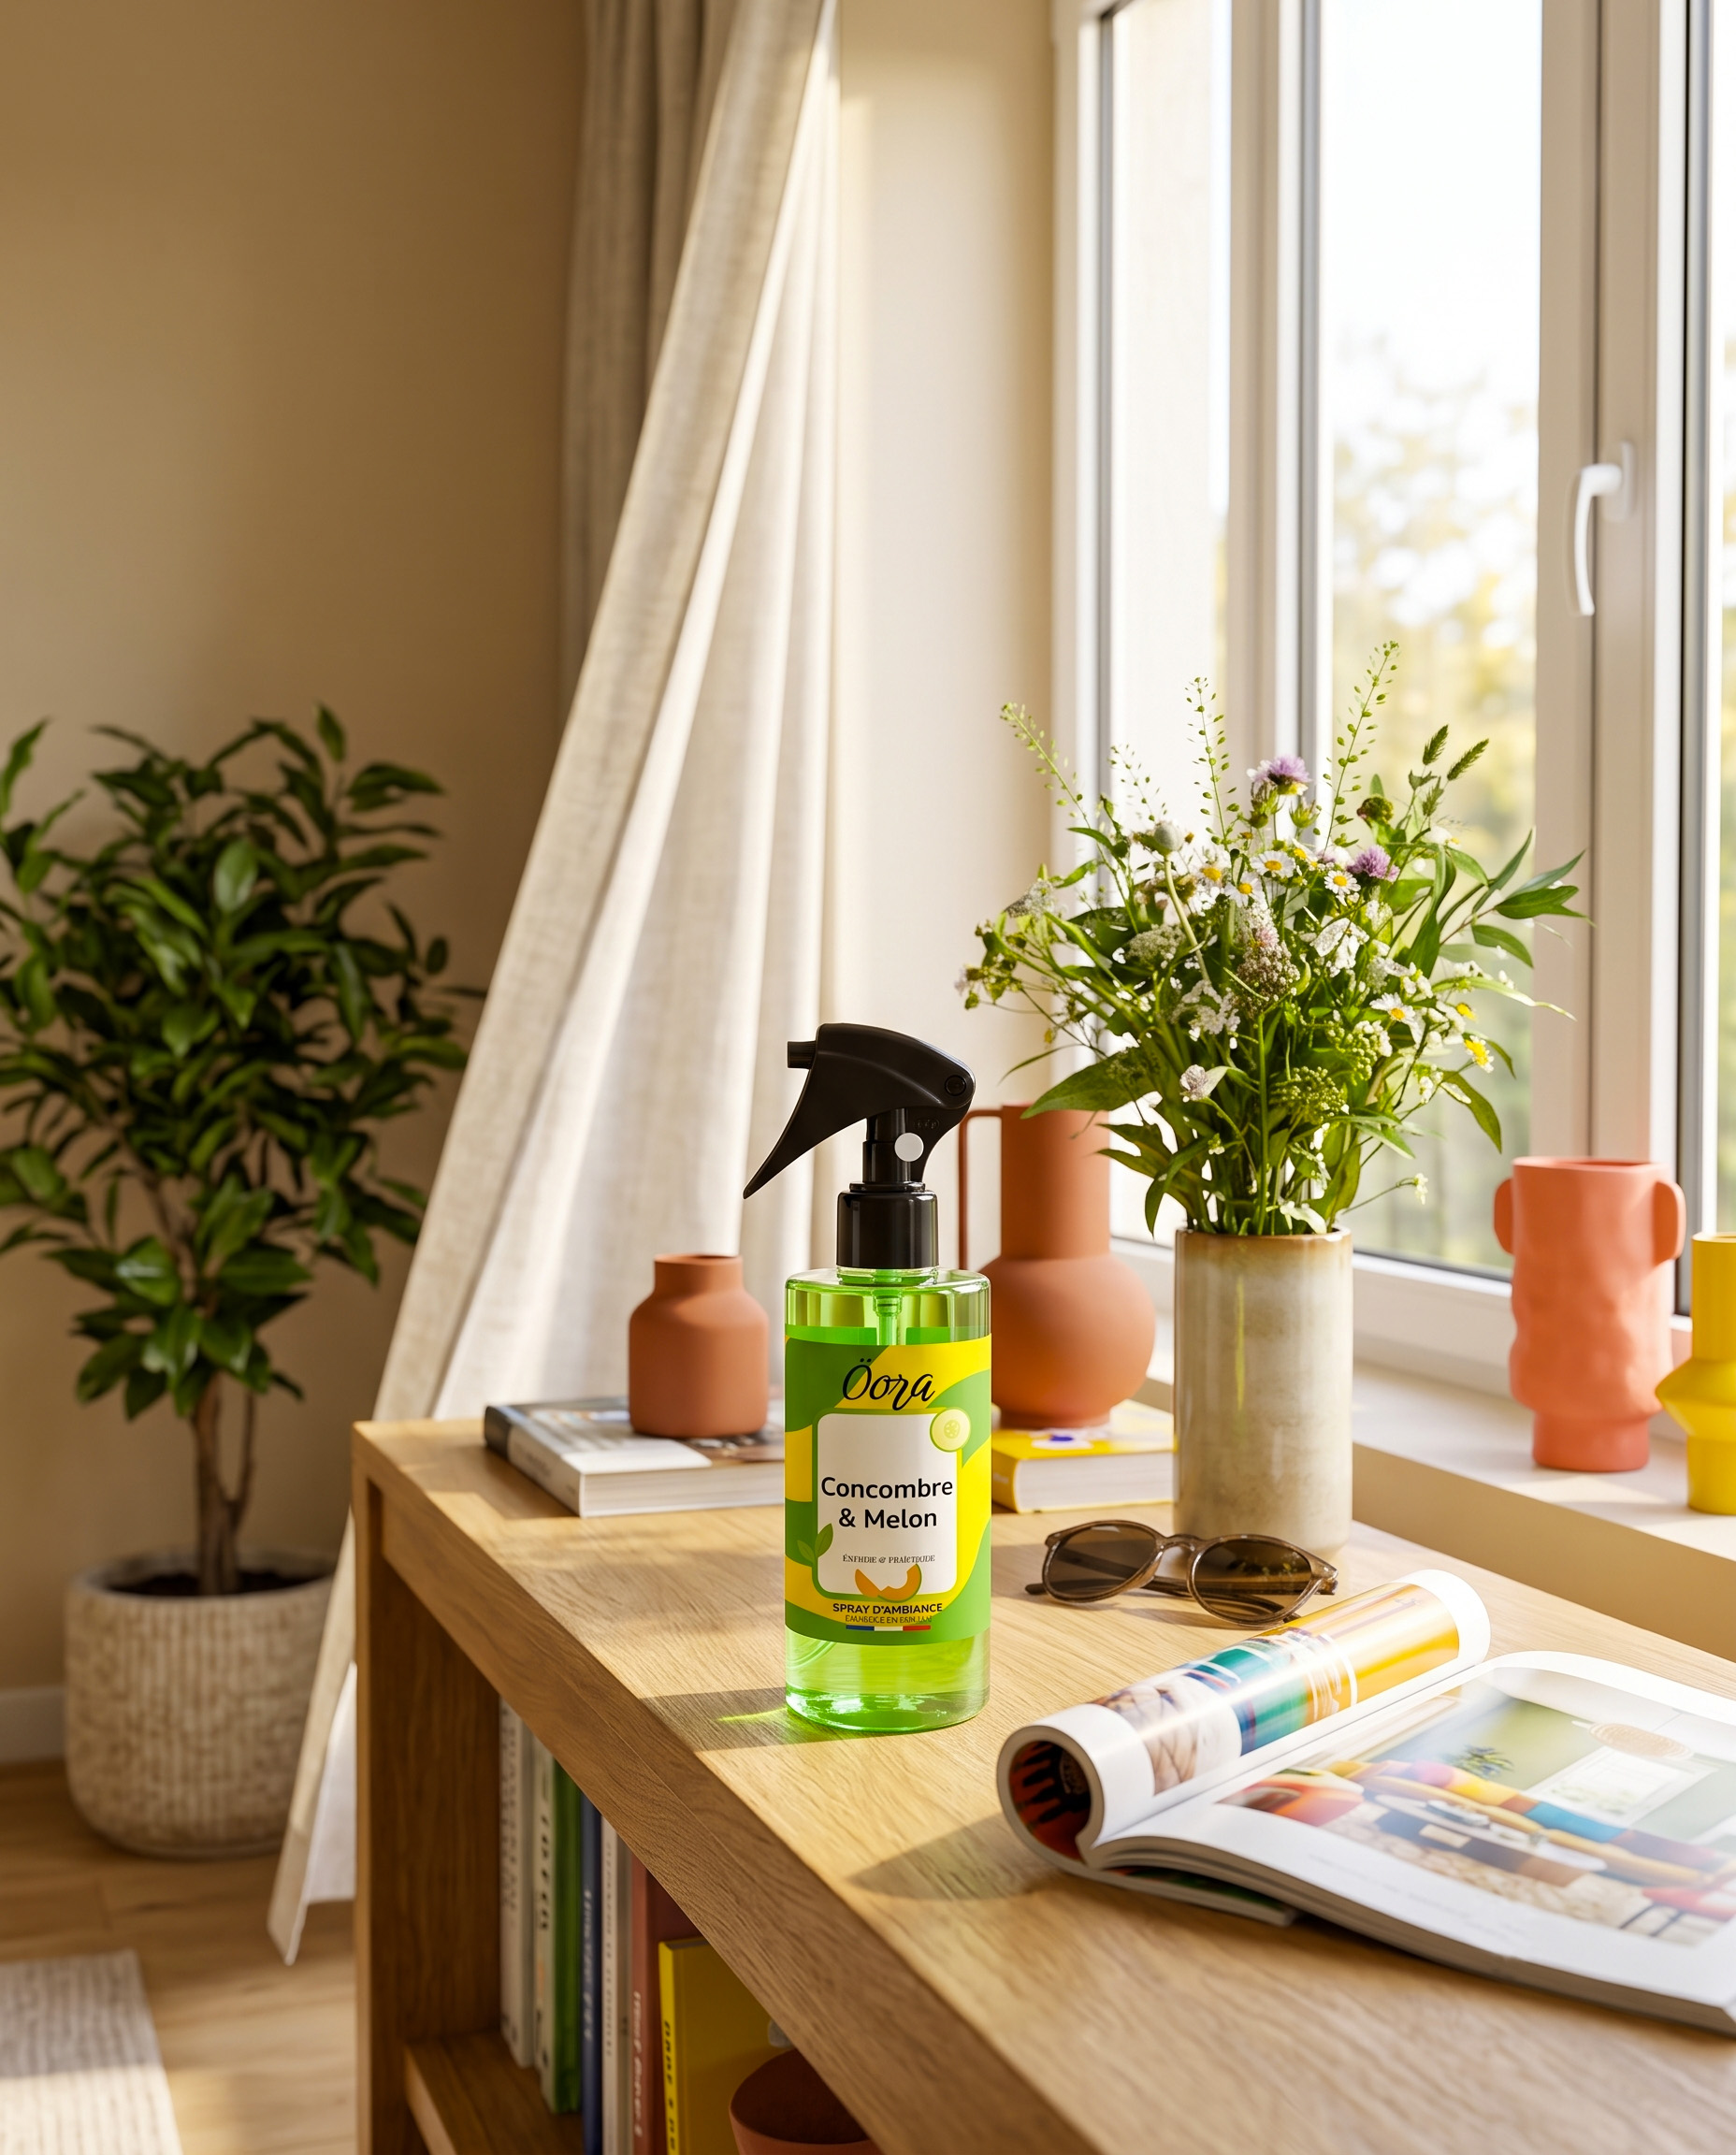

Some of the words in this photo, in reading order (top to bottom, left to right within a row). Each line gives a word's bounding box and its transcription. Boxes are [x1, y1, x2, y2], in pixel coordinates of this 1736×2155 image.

[842, 1358, 935, 1411] Öora
[821, 1477, 953, 1498] Concombre
[838, 1508, 856, 1527] &
[864, 1509, 937, 1528] Melon
[832, 1603, 870, 1613] SPRAY
[873, 1603, 943, 1614] D'AMBIANCE
